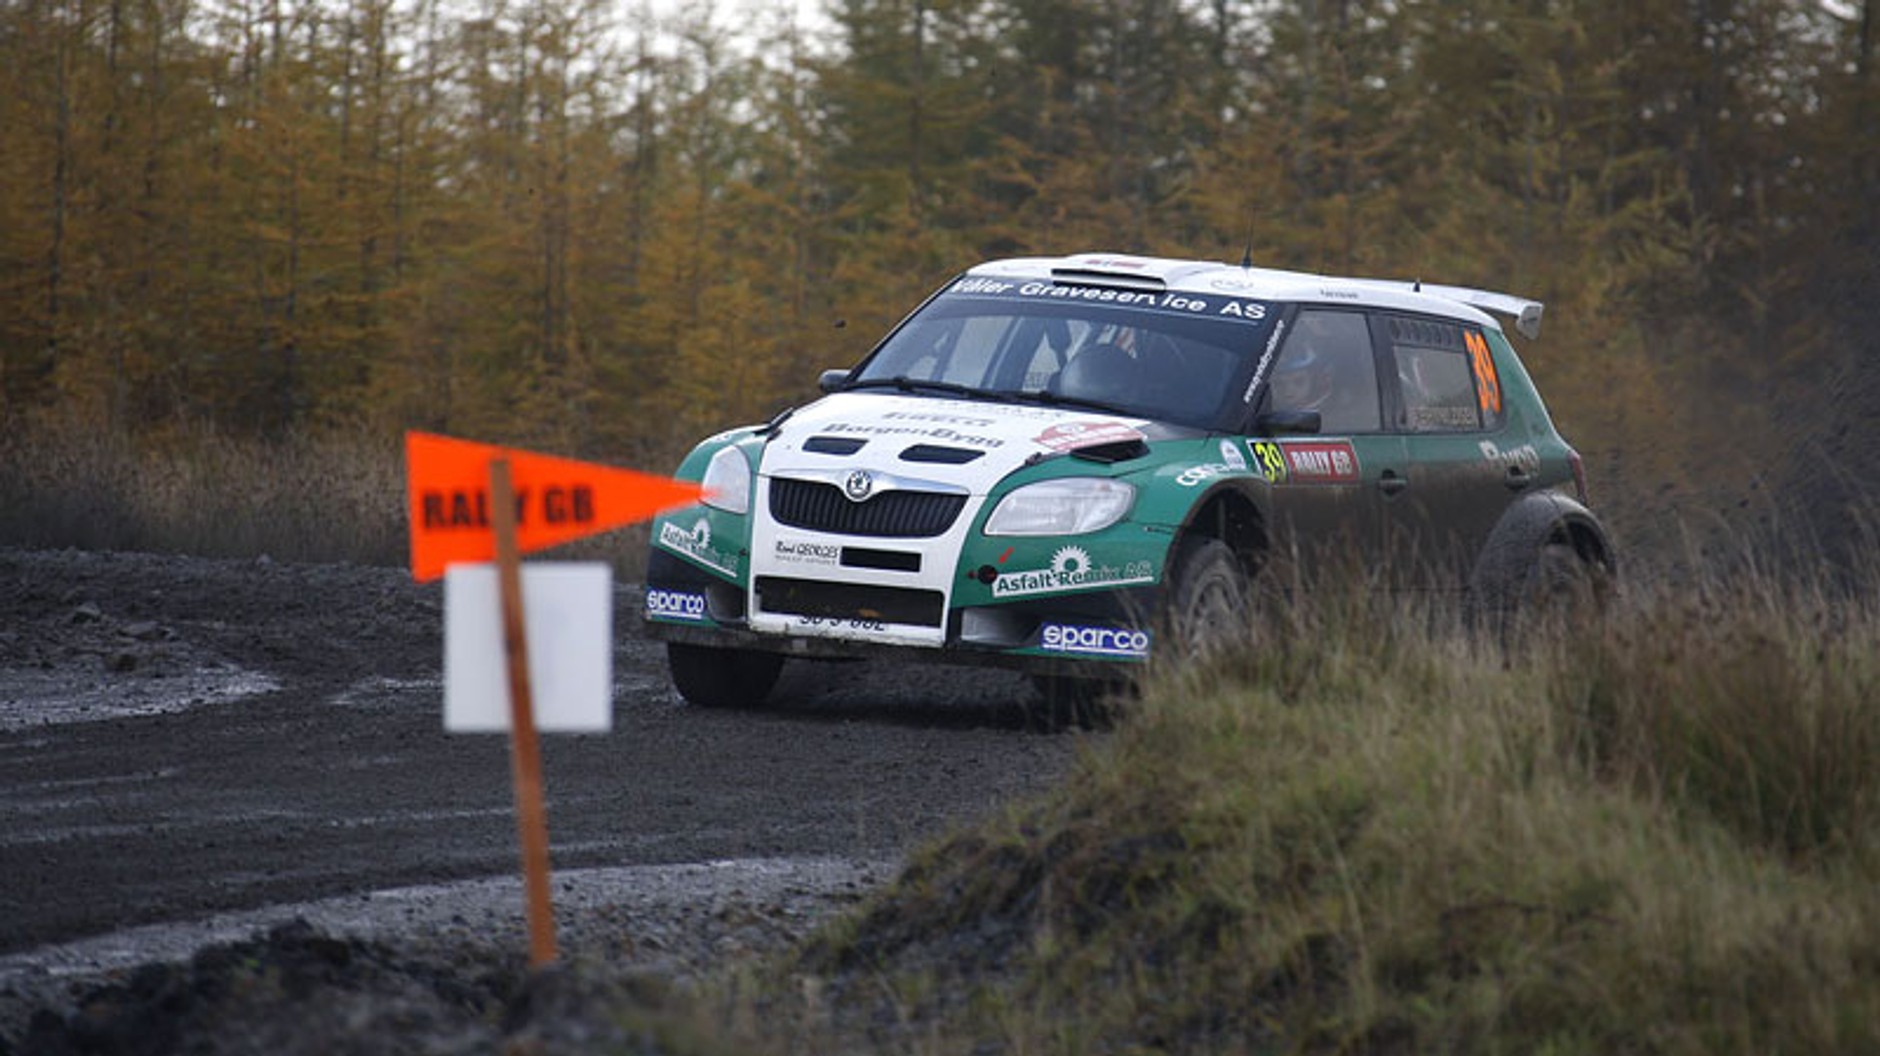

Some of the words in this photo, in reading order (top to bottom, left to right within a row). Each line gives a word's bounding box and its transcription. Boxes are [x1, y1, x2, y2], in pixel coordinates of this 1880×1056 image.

[1220, 301, 1266, 319] AS
[1464, 329, 1503, 413] 39
[822, 422, 1005, 448] BorgenBygg
[1254, 440, 1287, 484] 39
[1289, 450, 1332, 475] RALLY
[1330, 449, 1354, 475] GB
[423, 489, 527, 529] RALY
[544, 484, 595, 524] GB
[997, 570, 1053, 592] Asfalt
[647, 590, 704, 613] sparco
[1042, 624, 1149, 651] sparco
